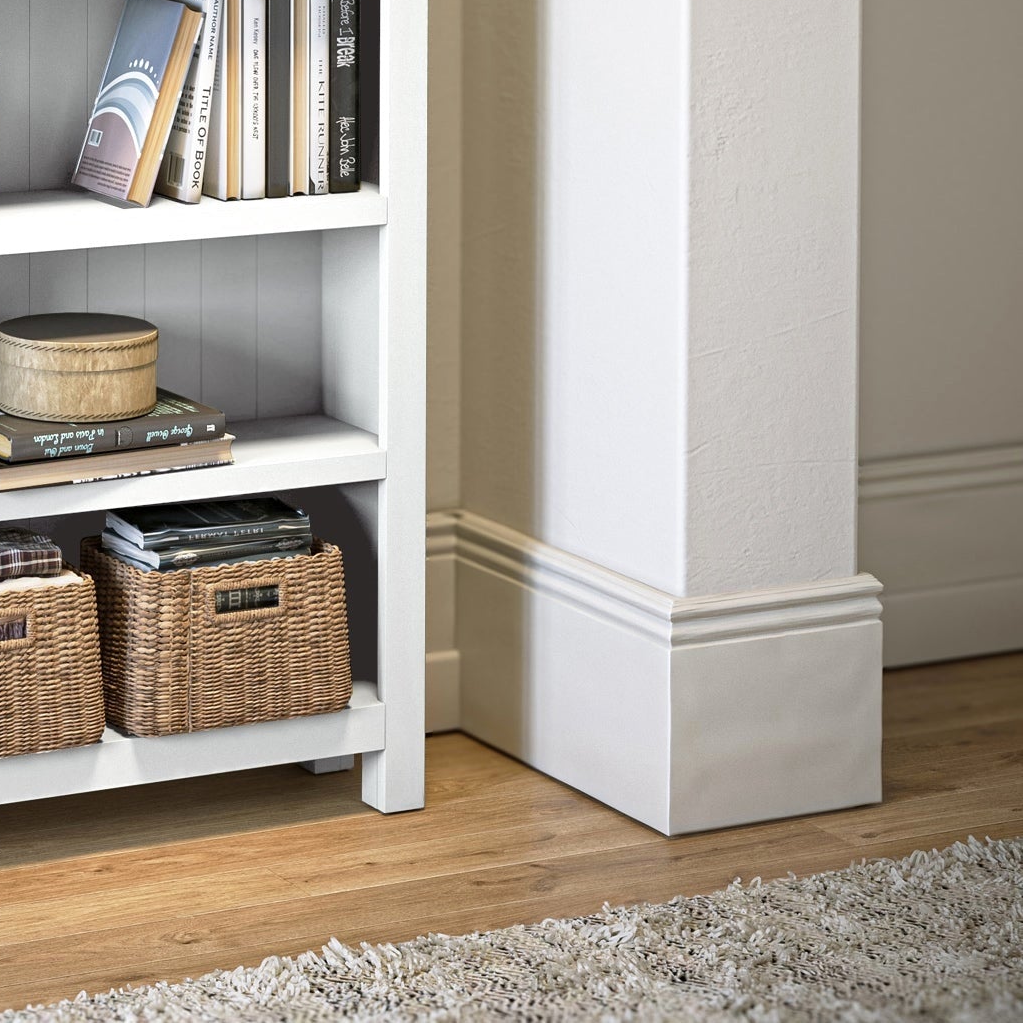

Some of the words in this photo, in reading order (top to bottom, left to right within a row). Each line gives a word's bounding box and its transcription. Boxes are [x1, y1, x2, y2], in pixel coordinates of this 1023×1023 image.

[339, 27, 354, 36] I
[208, 35, 216, 61] NAME
[199, 86, 212, 123] TITLE
[335, 116, 356, 133] Alec
[197, 127, 206, 147] OF
[339, 133, 356, 156] John
[317, 122, 325, 191] RUNNER
[191, 150, 204, 189] BOOK
[339, 156, 356, 178] Belle
[33, 432, 59, 447] London
[60, 430, 74, 444] and
[146, 427, 168, 443] Orwell
[169, 423, 194, 439] George
[60, 445, 73, 457] and
